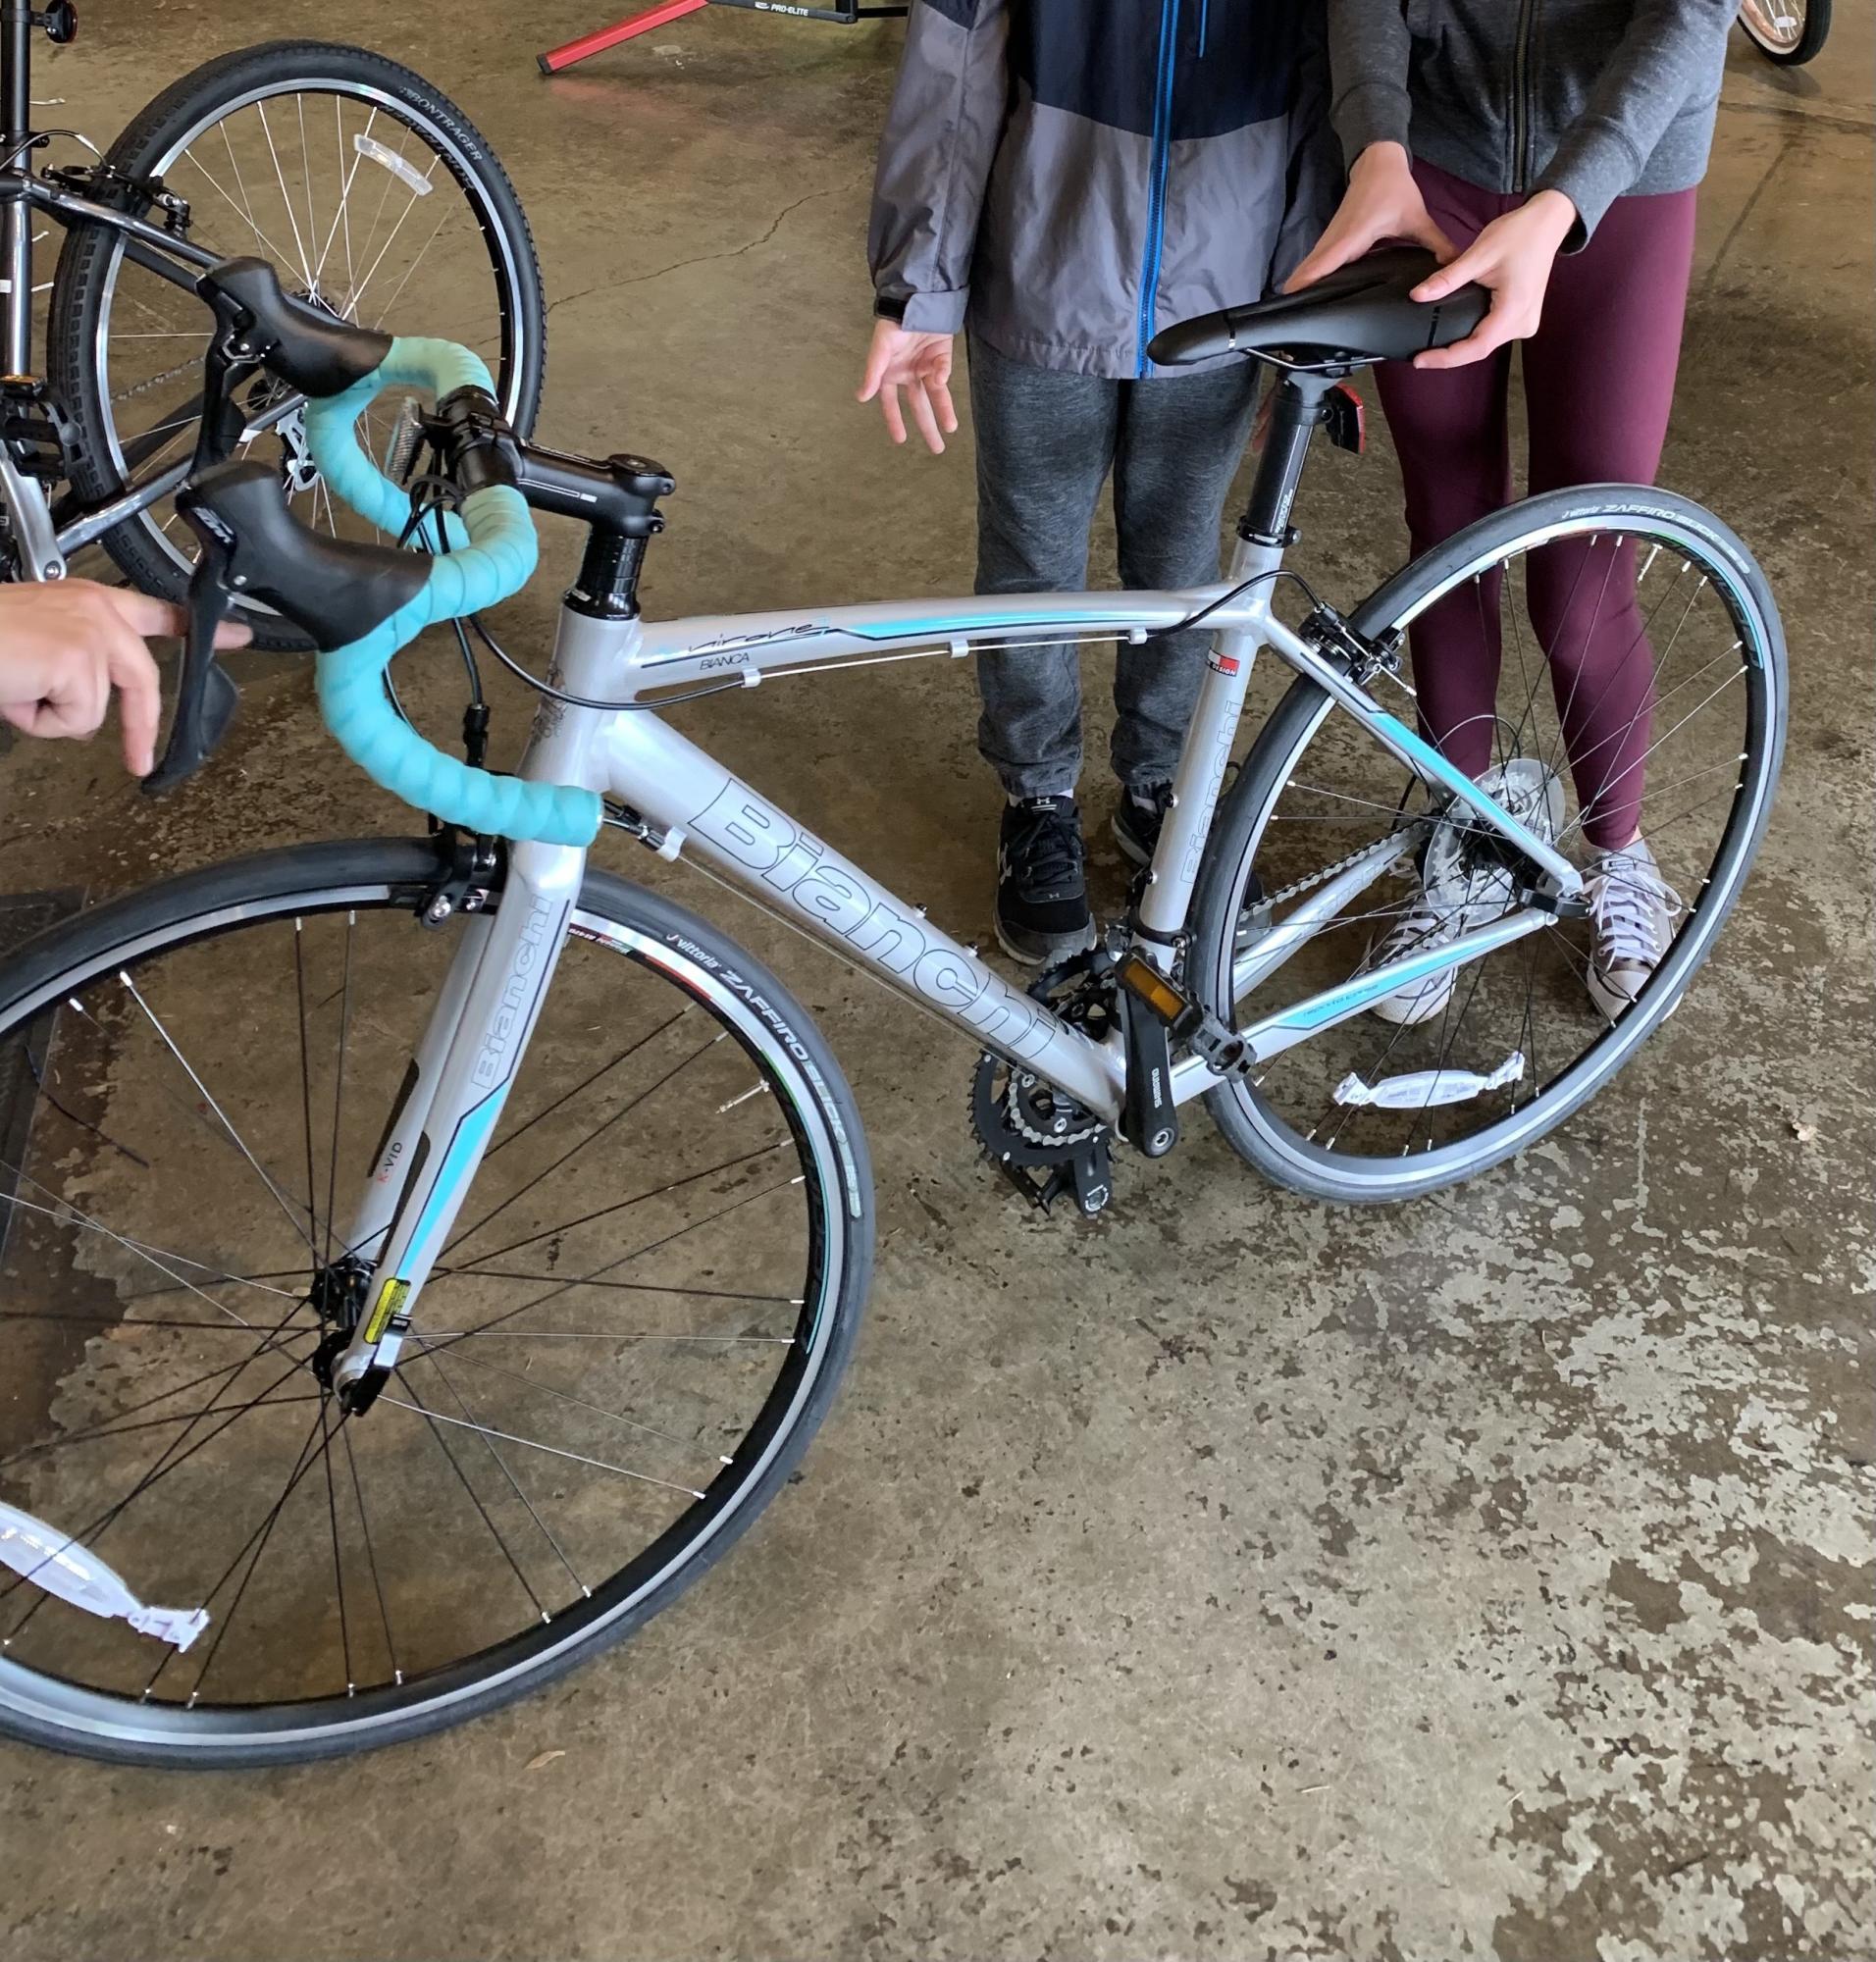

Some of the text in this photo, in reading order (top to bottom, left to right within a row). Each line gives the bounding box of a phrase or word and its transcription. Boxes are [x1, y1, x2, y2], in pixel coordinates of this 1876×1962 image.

[771, 3, 808, 17] PRO-ELITE
[410, 90, 483, 161] BONTRAGER
[1602, 503, 1676, 520] ZAFFIRO
[700, 652, 750, 670] BIANCA
[688, 778, 1060, 1059] Bianchi
[471, 893, 553, 1089] Bianchi
[676, 937, 718, 969] vittoria
[719, 969, 808, 1063] ZAFFIRO
